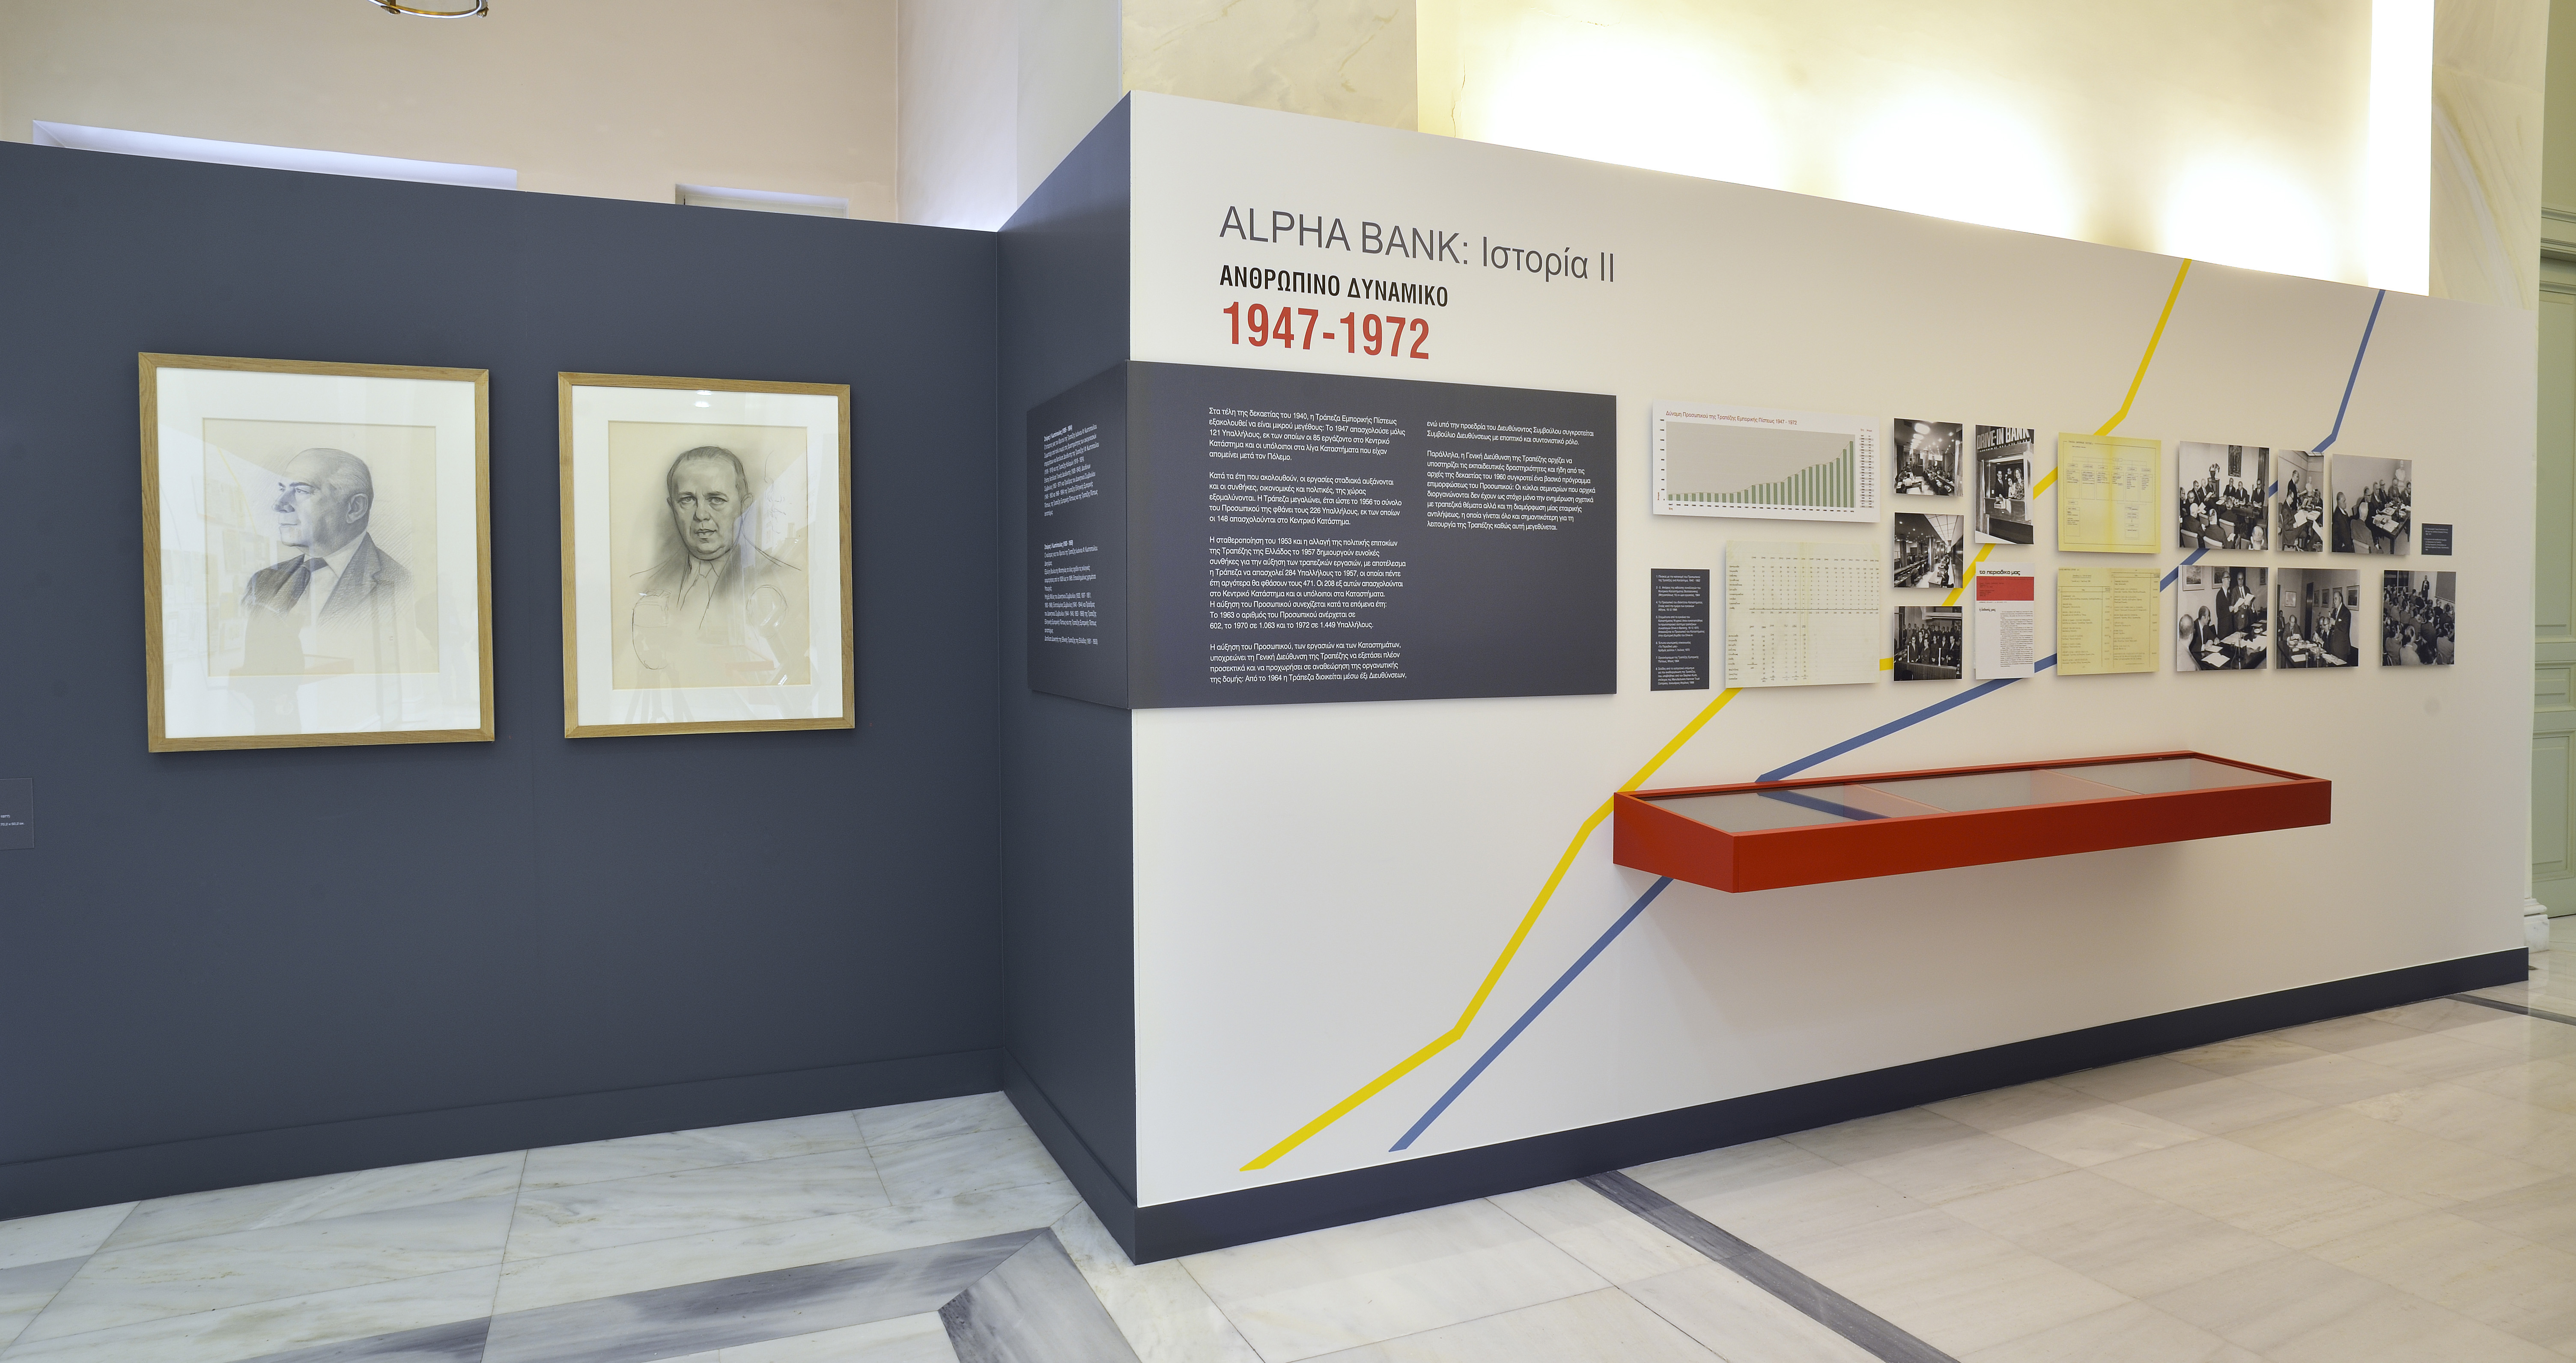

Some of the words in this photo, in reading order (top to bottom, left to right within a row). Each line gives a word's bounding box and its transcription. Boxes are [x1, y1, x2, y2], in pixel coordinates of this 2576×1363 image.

[1219, 206, 1351, 252] ALPHA
[1362, 221, 1468, 265] BANK:
[1483, 236, 1589, 283] Ιστορία
[1219, 265, 1340, 297] ΑΝΘΡΩΠΙΝΟ
[1347, 277, 1448, 307] ΔΥΝΑΜΙΚΟ
[1223, 301, 1429, 360] 1947-1972
[1221, 408, 1236, 417] τέλη
[1249, 410, 1279, 419] δεκαετίας
[1293, 412, 1309, 420] 1940,
[1315, 414, 1341, 423] Τράπεζα
[1342, 415, 1372, 425] Εμπορικής
[1374, 417, 1397, 426] Πίστεως
[1209, 418, 1247, 427] εξακολουθεί
[1294, 423, 1324, 432] μεγέθους:
[1390, 428, 1405, 437] μόλις
[1427, 430, 1455, 438] Συμβούλιο
[1533, 426, 1561, 435] Συμβούλου
[1222, 429, 1261, 440] Υπαλλήλους,
[1321, 434, 1352, 443] εργάζοντο
[1365, 437, 1390, 445] Κεντρικό
[1977, 428, 2004, 449] DRIVE-IN
[1209, 439, 1244, 449] Κατάστημα
[1263, 442, 1293, 450] υπόλοιποι
[1306, 444, 1319, 452] λίγα
[1320, 445, 1359, 454] Καταστήματα
[1372, 447, 1387, 456] είχαν
[1209, 451, 1238, 459] απομείνει
[1240, 452, 1255, 460] μετά
[1267, 452, 1292, 461] Πόλεμο.
[1235, 472, 1246, 482] έτη
[1260, 474, 1298, 482] ακολουθούν,
[1306, 476, 1333, 485] εργασίες
[1363, 478, 1394, 486] αυξάνονται
[1427, 470, 1444, 479] αρχές
[1455, 471, 1482, 480] δεκαετίας
[1562, 476, 1591, 485] πρόγραμμα
[1227, 483, 1258, 492] συνθήκες,
[1260, 485, 1294, 494] οικονομικές
[1306, 486, 1334, 495] πολιτικές,
[1347, 487, 1366, 496] χώρας
[1221, 547, 1252, 556] Τραπέζης
[1265, 548, 1291, 556] Ελλάδος
[1316, 549, 1354, 557] δημιουργούν
[1355, 549, 1380, 558] ευνοϊκές
[1223, 589, 1249, 598] Κεντρικό
[1251, 590, 1285, 598] Κατάστημα
[1345, 590, 1385, 598] Καταστήματα.
[1216, 600, 1240, 609] αύξηση
[1254, 600, 1291, 609] Προσωπικού
[1293, 601, 1326, 609] συνεχίζεται
[1351, 600, 1374, 609] επόμενα
[1375, 600, 1387, 608] έτη:
[1241, 611, 1267, 620] αριθμός
[1280, 611, 1317, 619] Προσωπικού
[1318, 611, 1347, 619] ανέρχεται
[1210, 664, 1245, 673] προσεκτικά
[1266, 663, 1303, 672] προχωρήσει
[1312, 662, 1350, 671] αναθεώρηση
[1362, 661, 1398, 670] οργανωτικής
